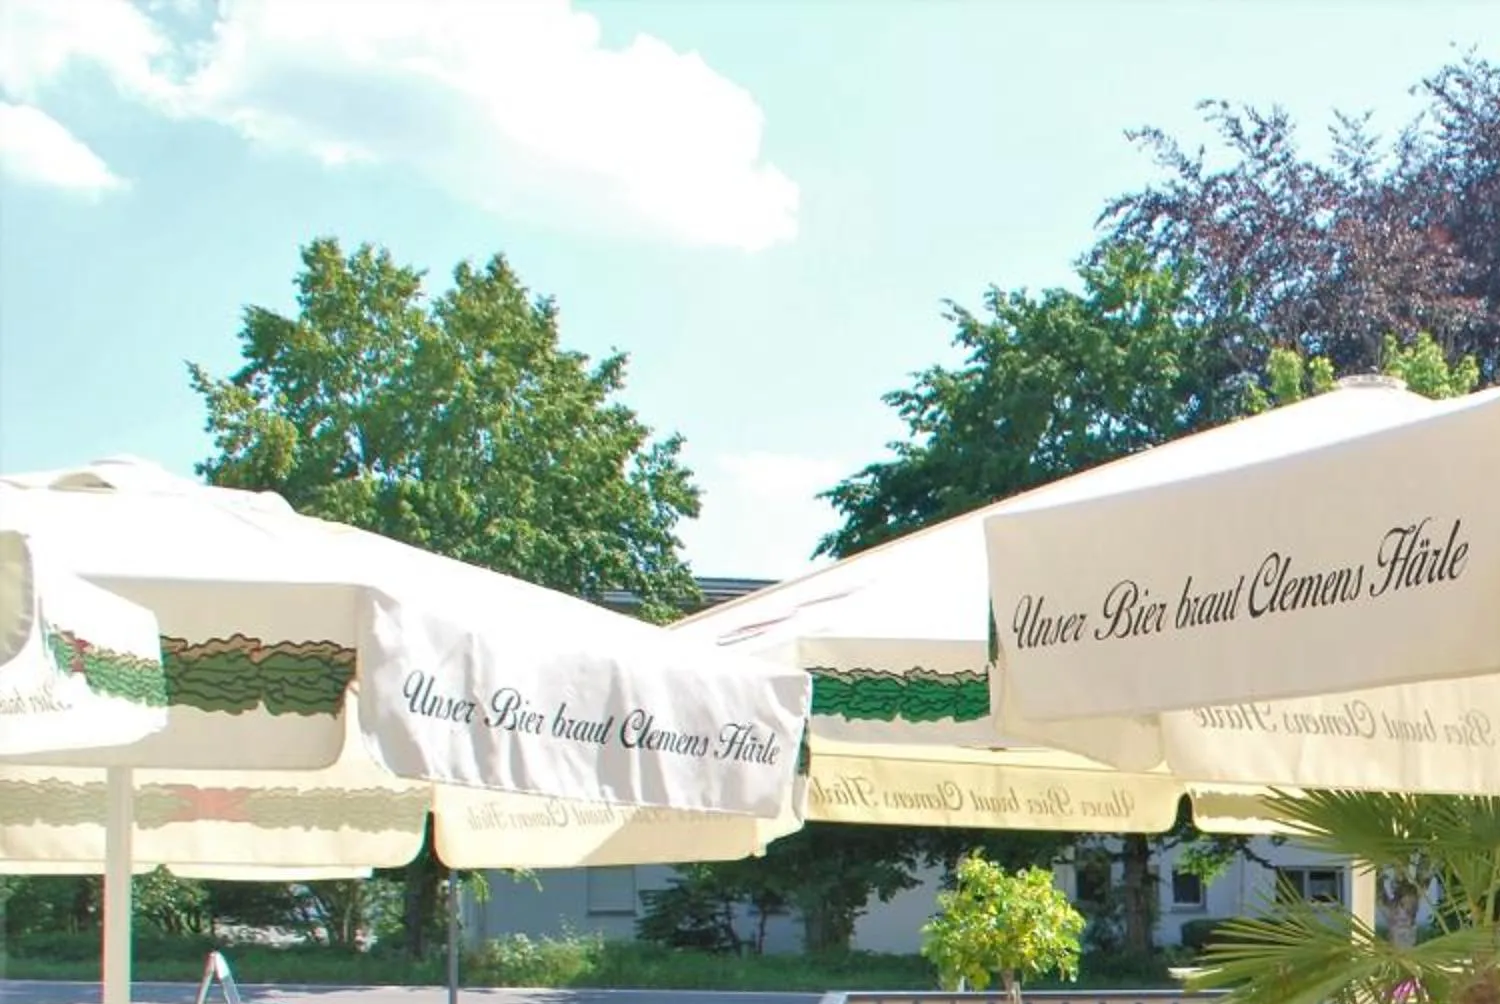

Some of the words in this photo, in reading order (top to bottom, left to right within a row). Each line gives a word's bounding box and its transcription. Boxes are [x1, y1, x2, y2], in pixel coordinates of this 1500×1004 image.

[1012, 596, 1086, 649] Unser
[1094, 580, 1168, 641] Bier
[1175, 575, 1245, 629] braut
[1248, 553, 1364, 618] Clemens
[1370, 517, 1470, 597] Härle
[402, 669, 476, 724] Unser
[484, 687, 545, 734] Bier
[551, 703, 615, 746] braut
[620, 709, 710, 758] Clemens
[713, 720, 781, 766] Härle
